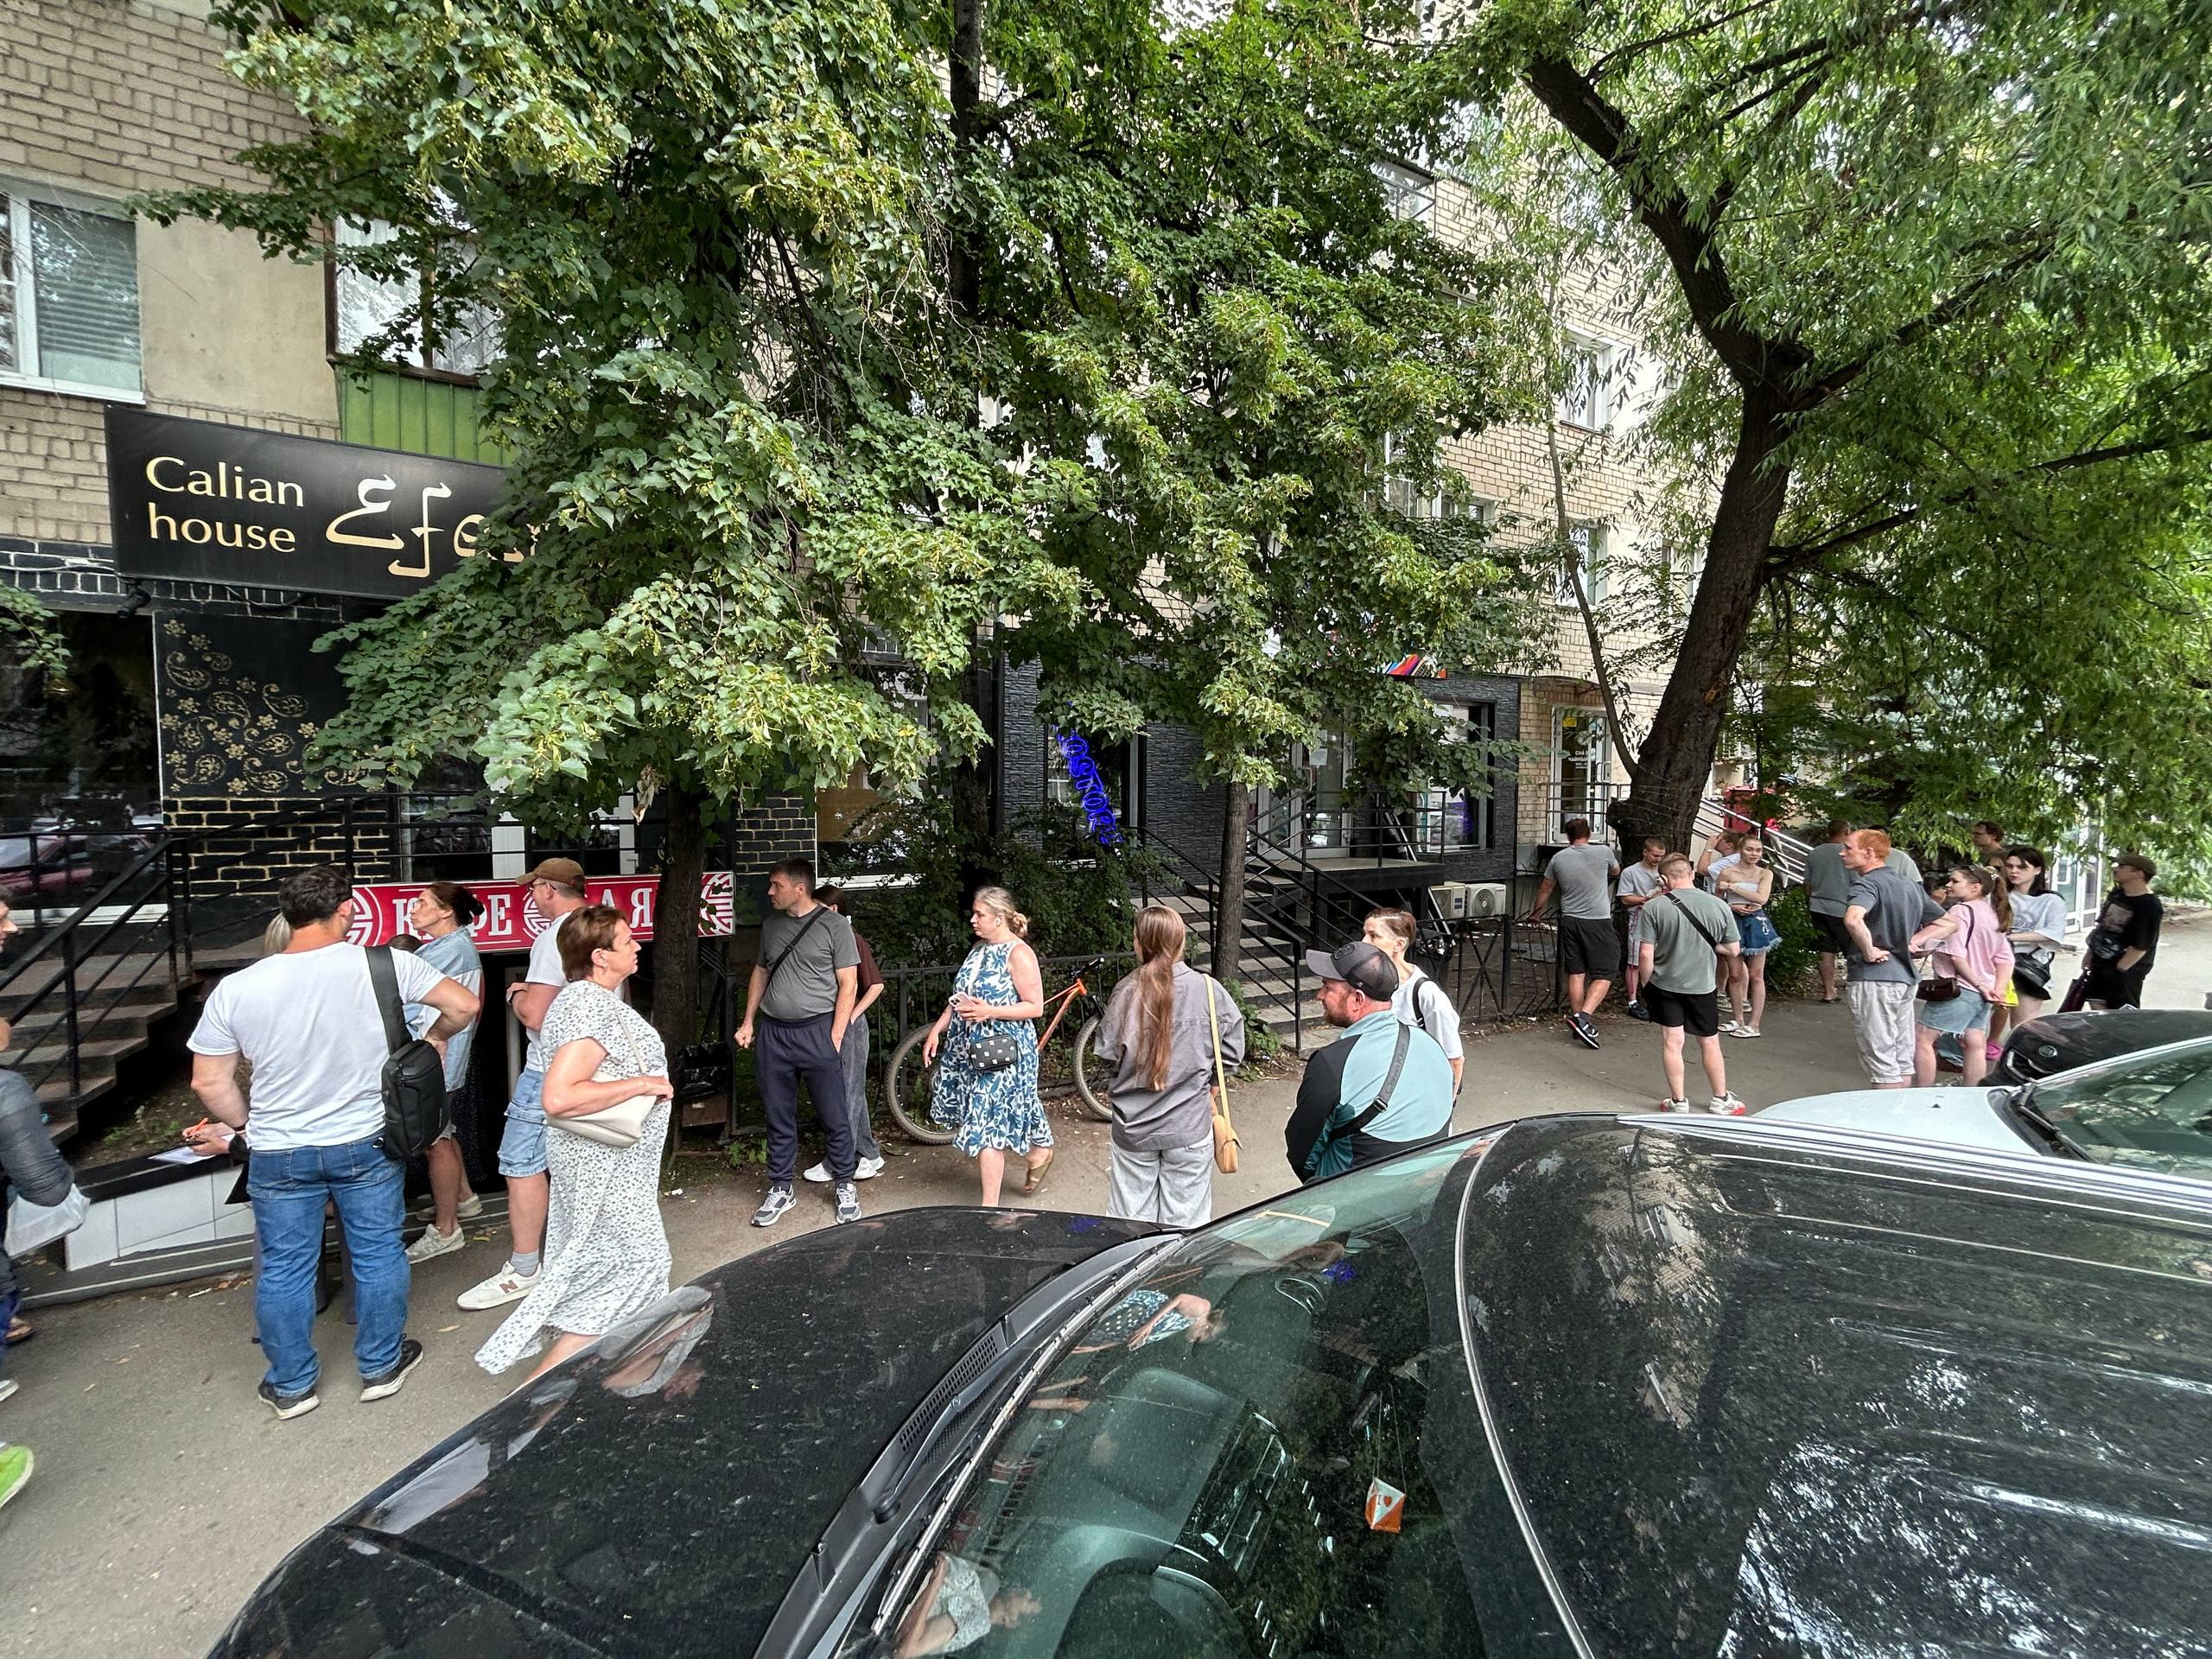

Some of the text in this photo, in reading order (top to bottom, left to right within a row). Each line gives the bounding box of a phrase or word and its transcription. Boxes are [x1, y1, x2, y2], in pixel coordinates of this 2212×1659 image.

[145, 455, 304, 508] Calian
[148, 502, 296, 553] house
[499, 1279, 519, 1294] N
